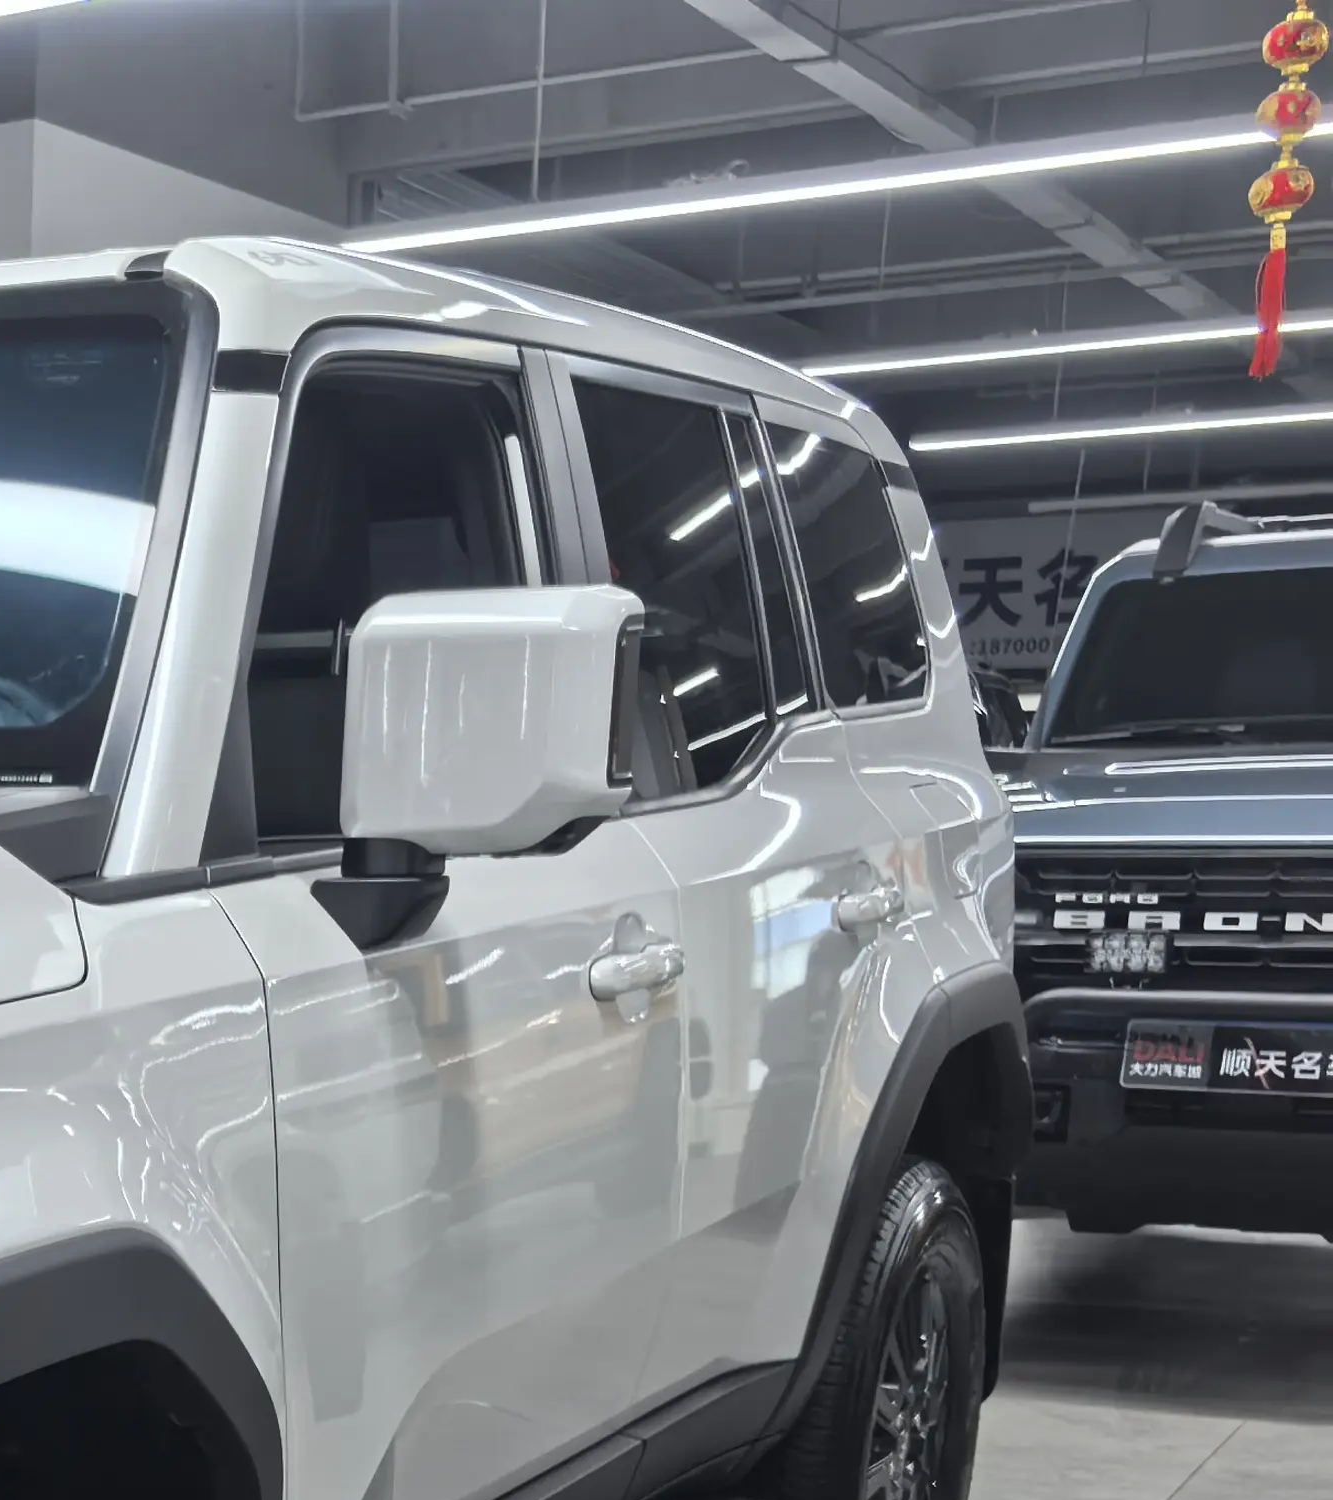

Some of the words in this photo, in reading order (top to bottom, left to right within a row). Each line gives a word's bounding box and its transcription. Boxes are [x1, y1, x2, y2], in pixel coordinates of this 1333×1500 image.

[943, 548, 1099, 627] 天名
[1133, 1038, 1205, 1063] DALI
[1219, 1046, 1333, 1080] 顺天名
